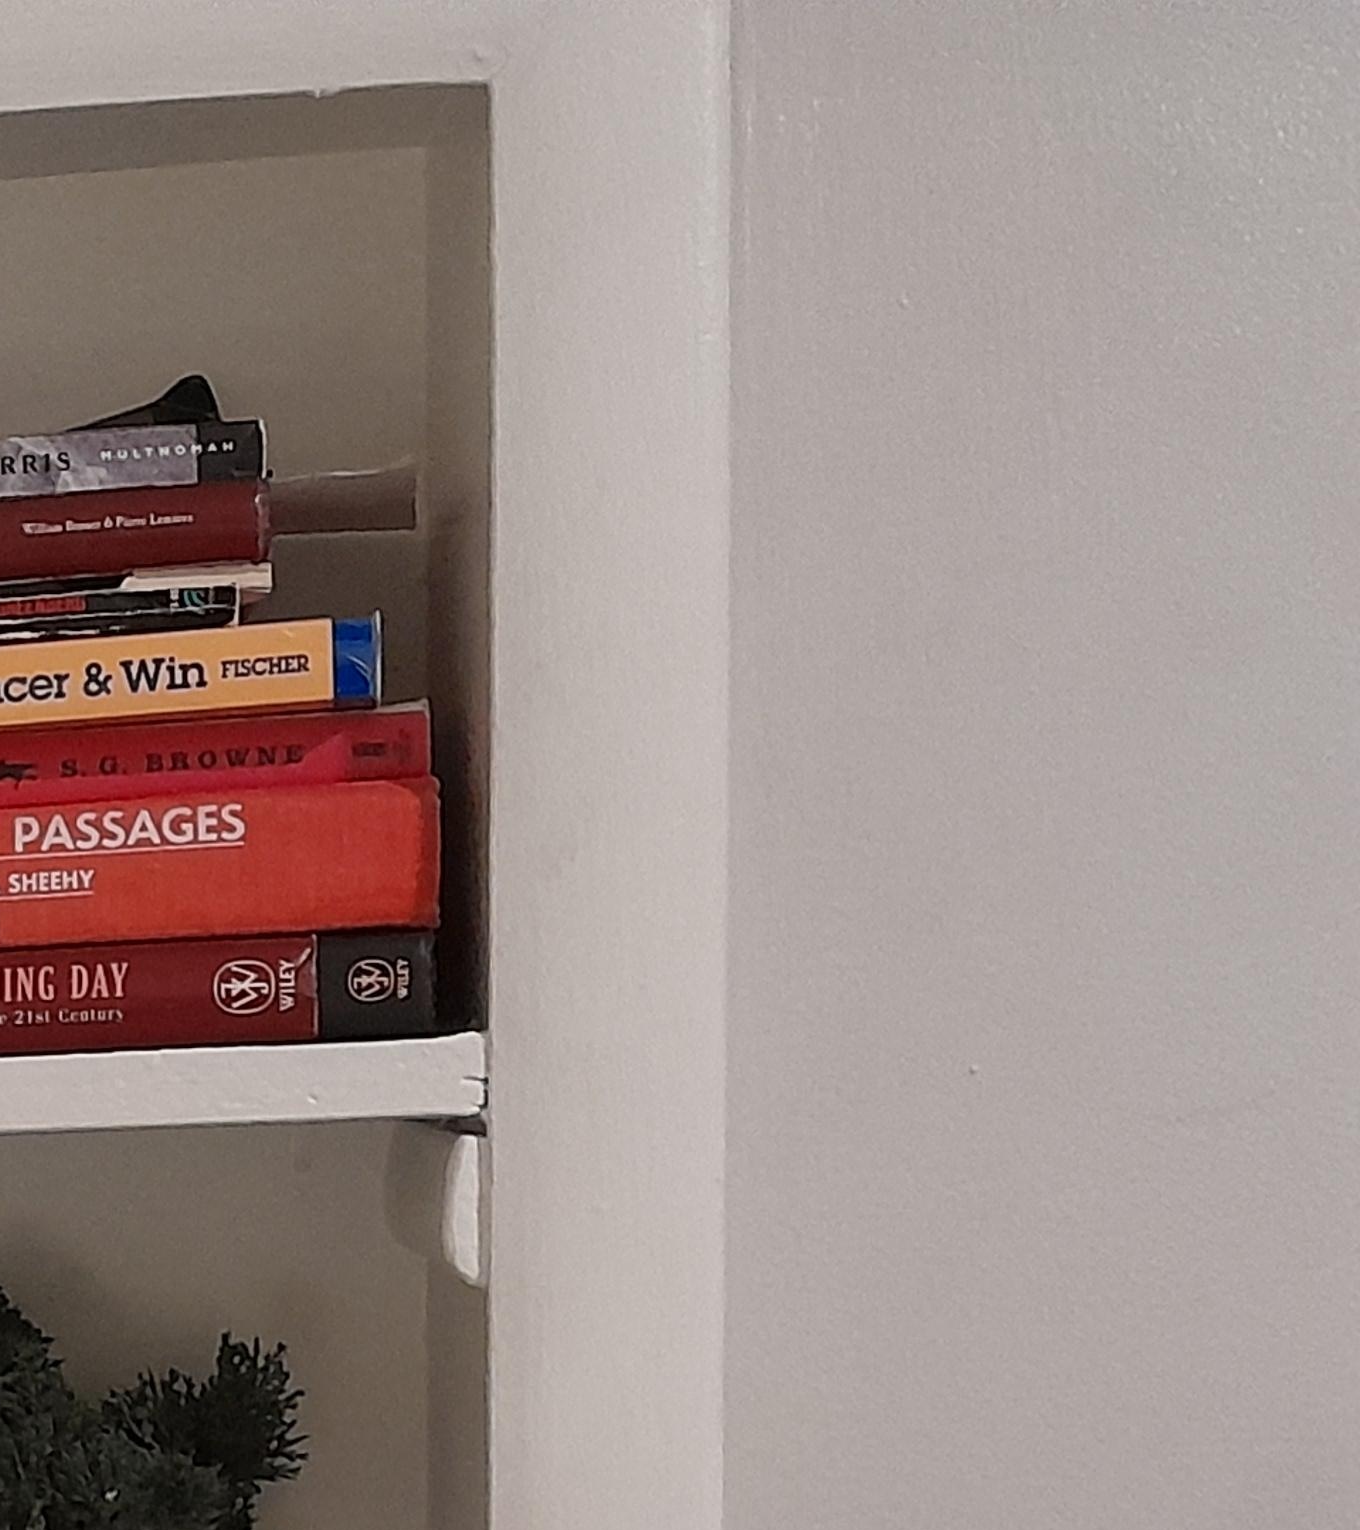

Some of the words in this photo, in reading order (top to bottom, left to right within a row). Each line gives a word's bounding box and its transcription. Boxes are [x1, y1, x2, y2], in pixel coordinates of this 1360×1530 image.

[99, 441, 235, 462] MULTNOMAH
[83, 662, 113, 697] &
[119, 656, 208, 694] Win
[220, 654, 310, 679] FISCHER
[61, 759, 87, 778] S.
[99, 755, 128, 777] G.
[145, 743, 305, 771] BROWNE
[14, 803, 246, 852] PASSAGES
[7, 869, 95, 895] SHEEHY
[70, 962, 129, 1000] DAY
[279, 959, 296, 1012] WILEY
[395, 957, 409, 1000] WILEY
[14, 1007, 51, 1026] 21st
[58, 1007, 124, 1024] Century
